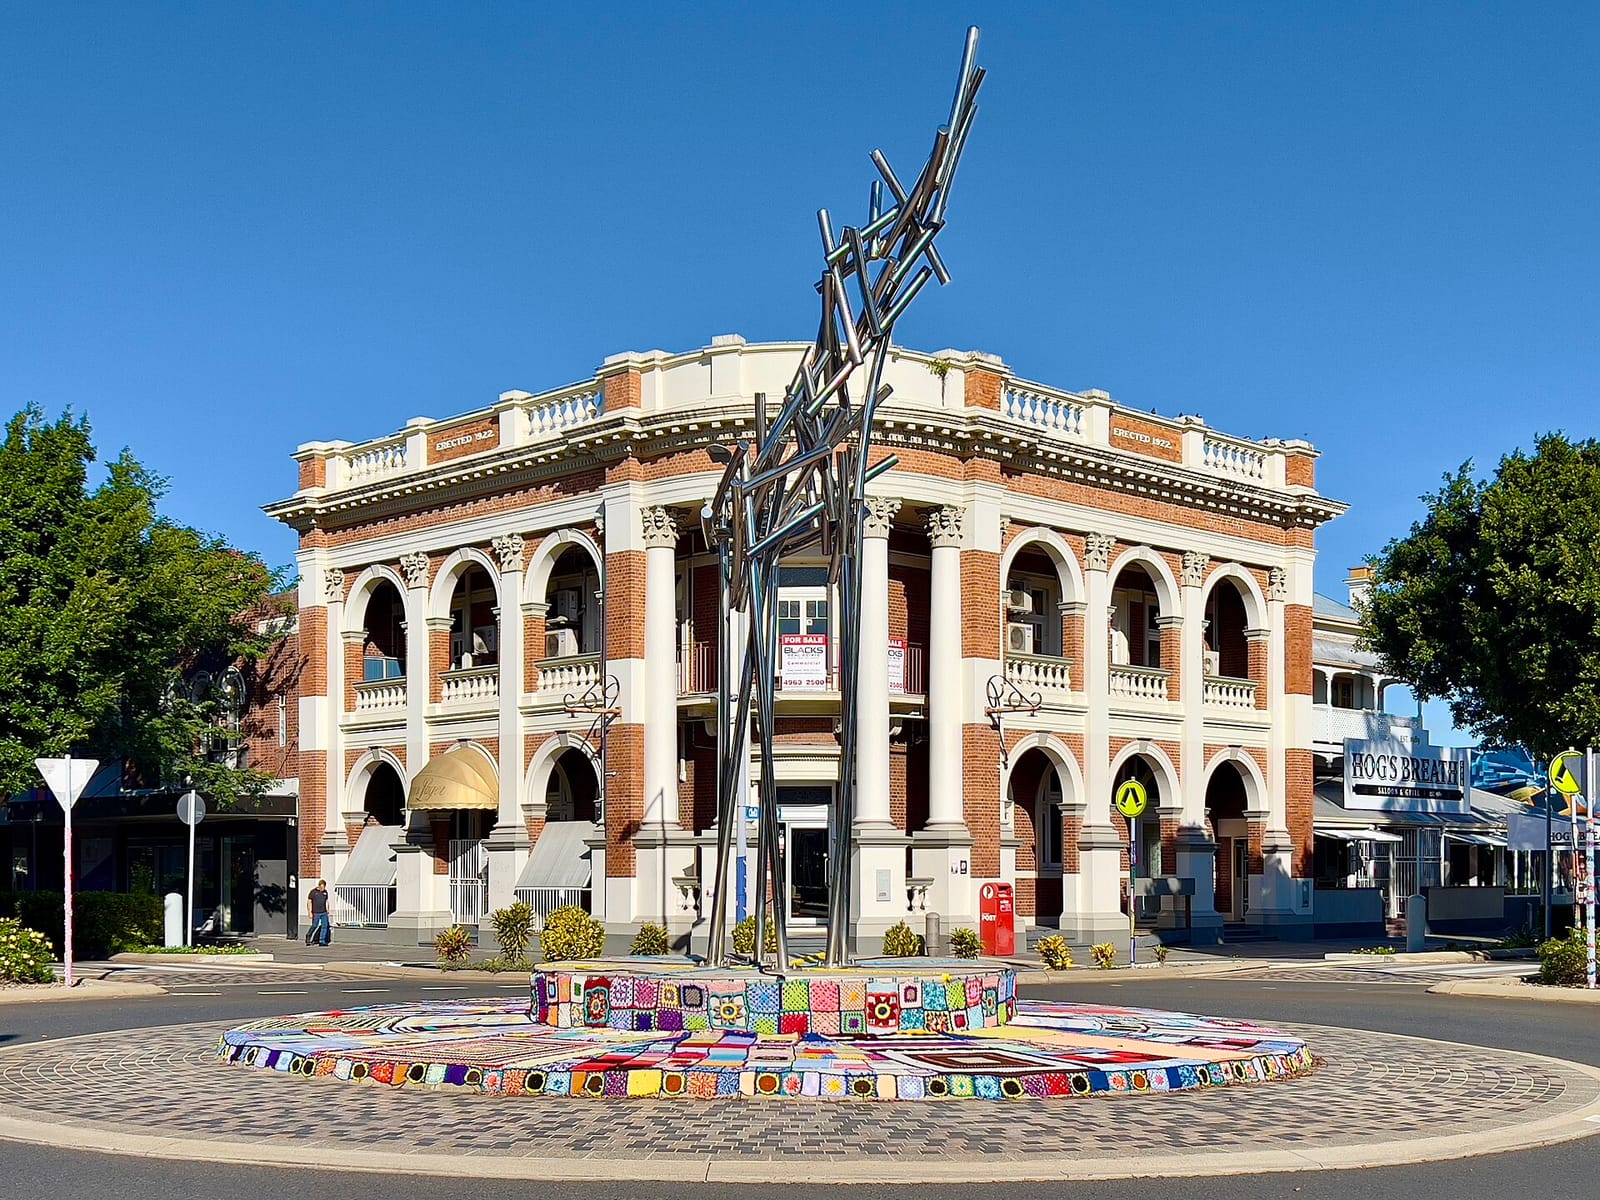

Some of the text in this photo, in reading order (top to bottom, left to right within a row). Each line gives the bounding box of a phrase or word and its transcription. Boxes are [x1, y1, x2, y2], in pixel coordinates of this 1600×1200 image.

[436, 435, 472, 450] ERECTED
[1113, 427, 1172, 449] ERECTED 1922
[1352, 753, 1459, 784] HOG'S BREATH
